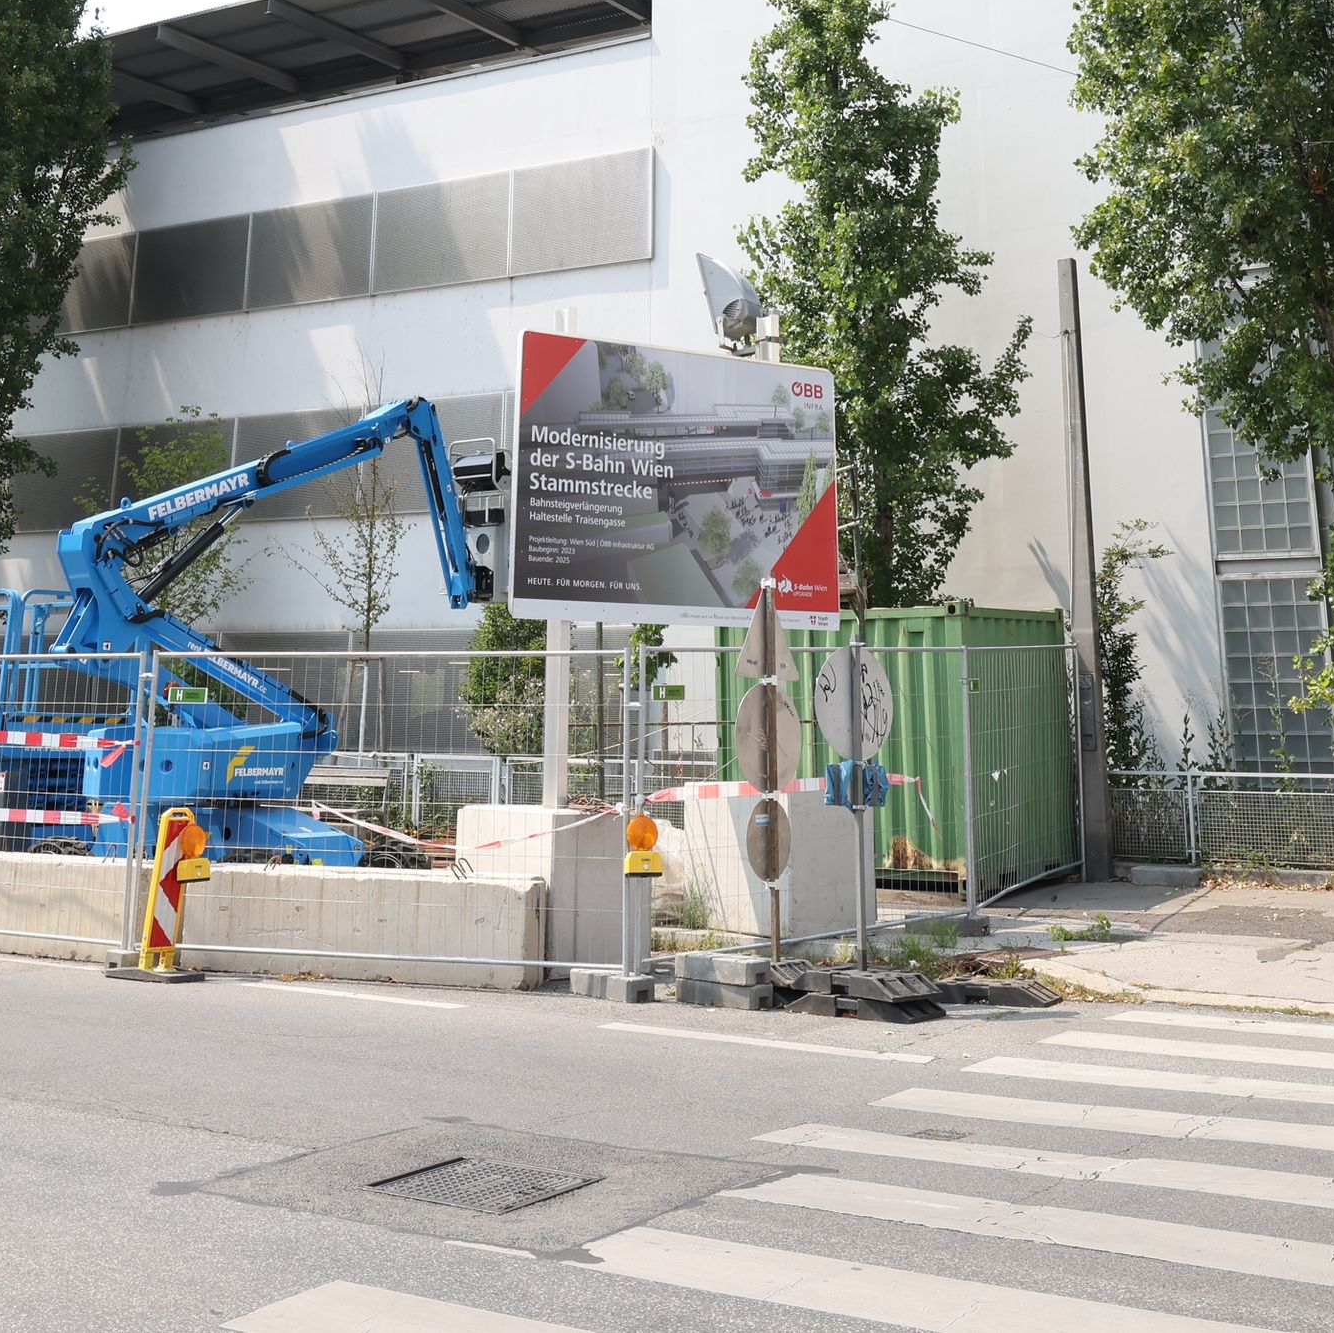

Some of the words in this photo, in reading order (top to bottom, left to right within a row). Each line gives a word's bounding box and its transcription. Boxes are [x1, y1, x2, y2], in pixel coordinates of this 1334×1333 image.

[791, 381, 823, 399] ÖBB
[803, 402, 824, 411] INFRA
[531, 425, 665, 460] Modernisierung
[530, 448, 559, 468] der
[566, 452, 625, 474] S-Bahn
[631, 458, 674, 479] Wien
[529, 472, 653, 499] Stammstrecke
[148, 472, 250, 521] FELBERMAYR
[530, 497, 623, 516] Bahnsteigverlängerung
[529, 511, 573, 524] Haltestelle
[575, 515, 626, 529] Traisengasse
[569, 538, 585, 546] Wien
[561, 547, 576, 555] 2023
[555, 556, 570, 564] 2025
[527, 578, 554, 586] HEUTE.
[556, 578, 571, 587] FÜR
[572, 579, 607, 589] MORGEN.
[609, 580, 624, 590] FÜR
[625, 582, 642, 591] UNS.
[793, 583, 814, 591] S-Bahn
[813, 584, 827, 592] Wien
[176, 689, 183, 701] H
[659, 686, 666, 699] H
[234, 767, 284, 777] FELBERMAYR
